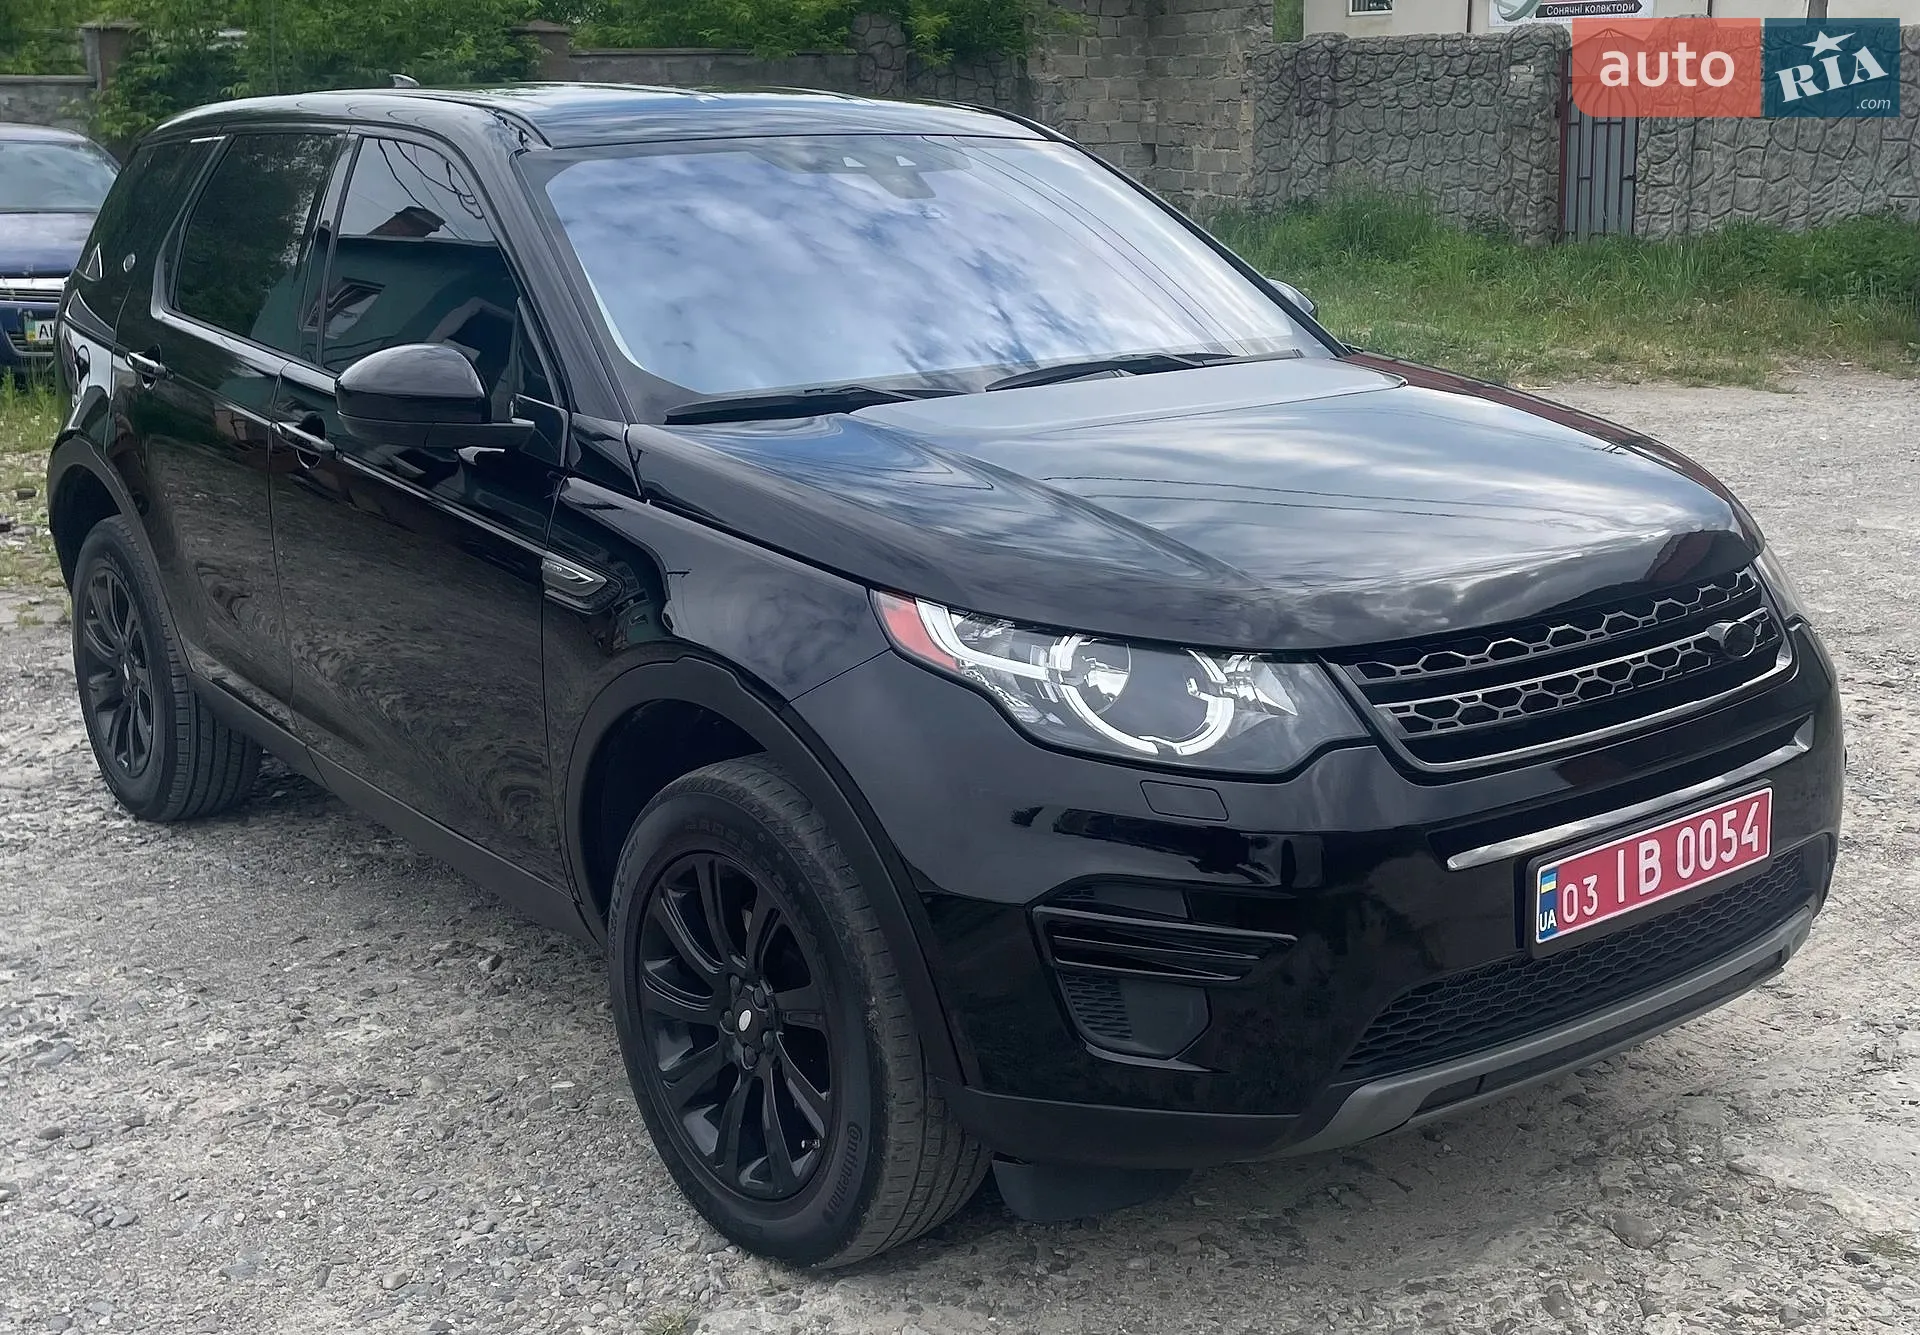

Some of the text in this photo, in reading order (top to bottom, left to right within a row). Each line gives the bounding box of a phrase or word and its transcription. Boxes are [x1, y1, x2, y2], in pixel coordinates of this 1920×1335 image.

[1546, 3, 1635, 16] Сонячні колектори
[1539, 909, 1557, 932] UA
[1676, 801, 1759, 880] 0054
